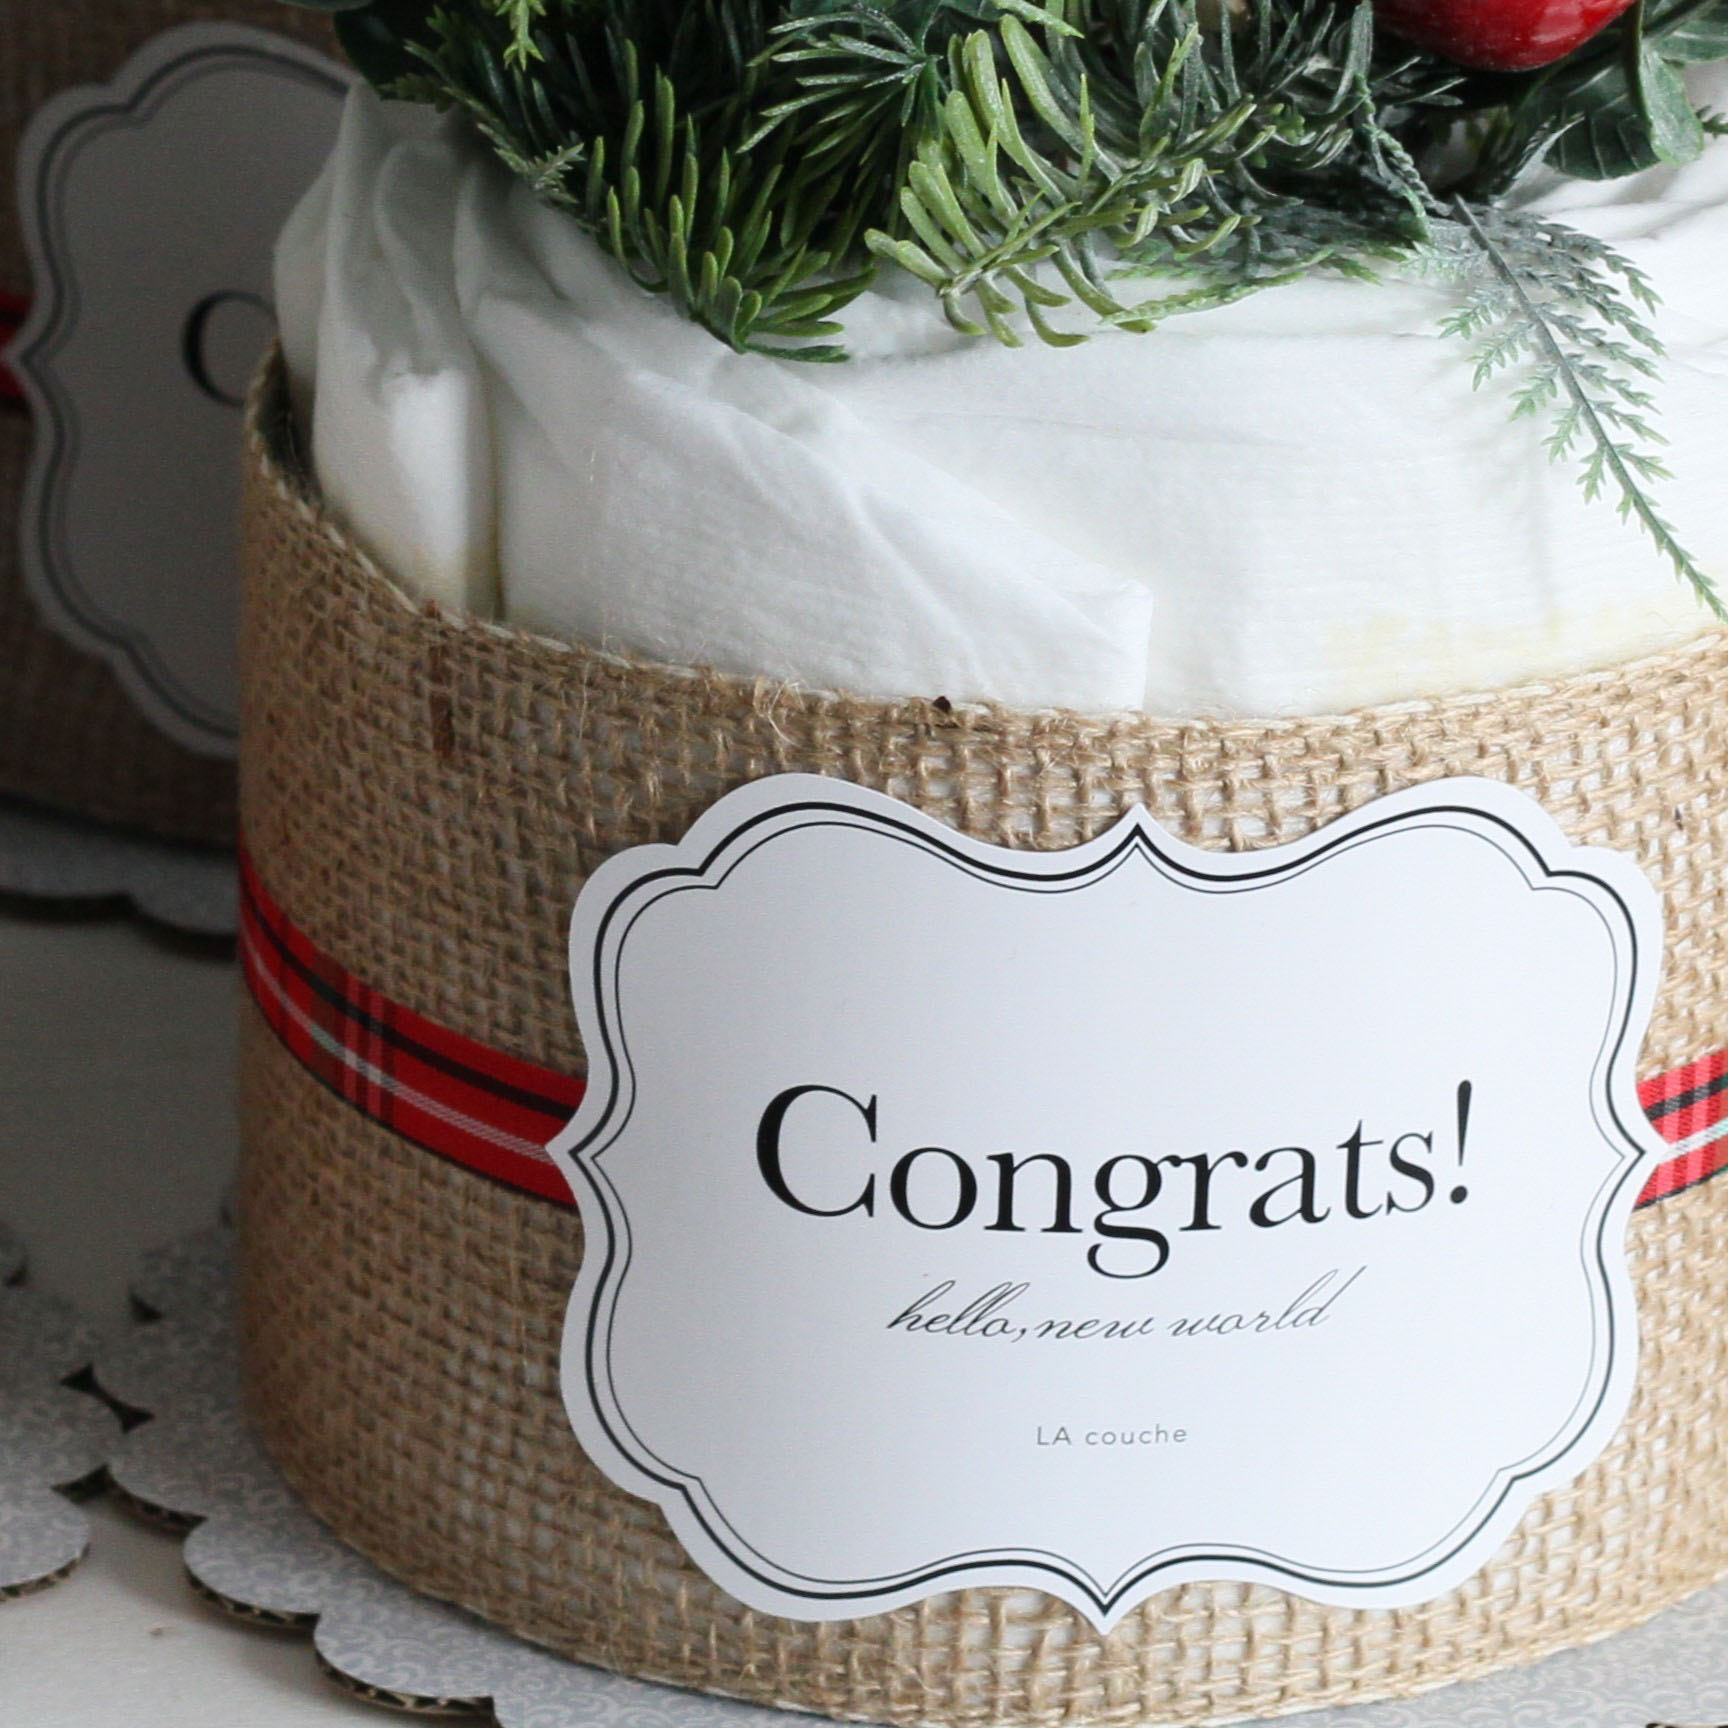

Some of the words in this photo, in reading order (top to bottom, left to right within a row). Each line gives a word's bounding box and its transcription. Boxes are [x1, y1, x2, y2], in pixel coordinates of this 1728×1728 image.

[755, 1079, 1473, 1280] Congrats!
[1166, 1265, 1368, 1338] world
[1036, 1425, 1072, 1447] LA
[1084, 1423, 1189, 1447] couche
